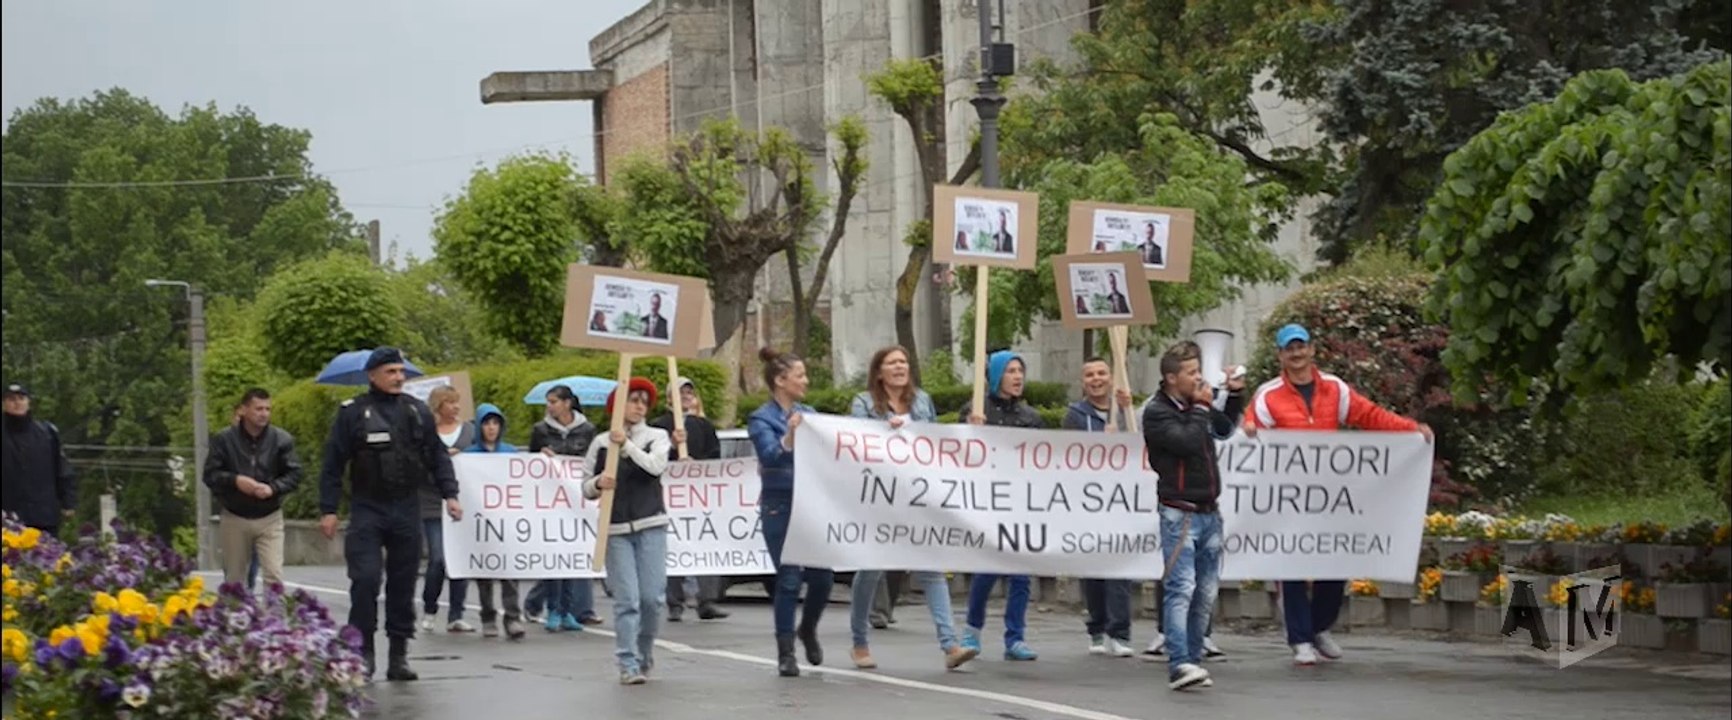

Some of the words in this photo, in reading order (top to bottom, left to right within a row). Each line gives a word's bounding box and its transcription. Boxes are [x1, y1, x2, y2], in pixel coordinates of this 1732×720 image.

[834, 431, 997, 469] RECORD:
[1014, 441, 1128, 471] 10.000
[667, 459, 745, 479] UBLIC
[483, 484, 523, 510] DE
[534, 484, 572, 509] LA
[860, 468, 898, 505] ÎN
[909, 480, 930, 508] 2
[940, 479, 1013, 512] ZILE
[1026, 482, 1072, 512] LA
[1226, 484, 1364, 515] TURDA.
[474, 513, 505, 543] ÎN
[515, 518, 531, 543] 9
[542, 518, 598, 543] LUN
[826, 521, 867, 544] NOI
[875, 523, 986, 550] SPUNEM
[997, 522, 1048, 553] NU
[1223, 533, 1392, 556] ONDUCEREA!
[469, 553, 507, 571] NOI
